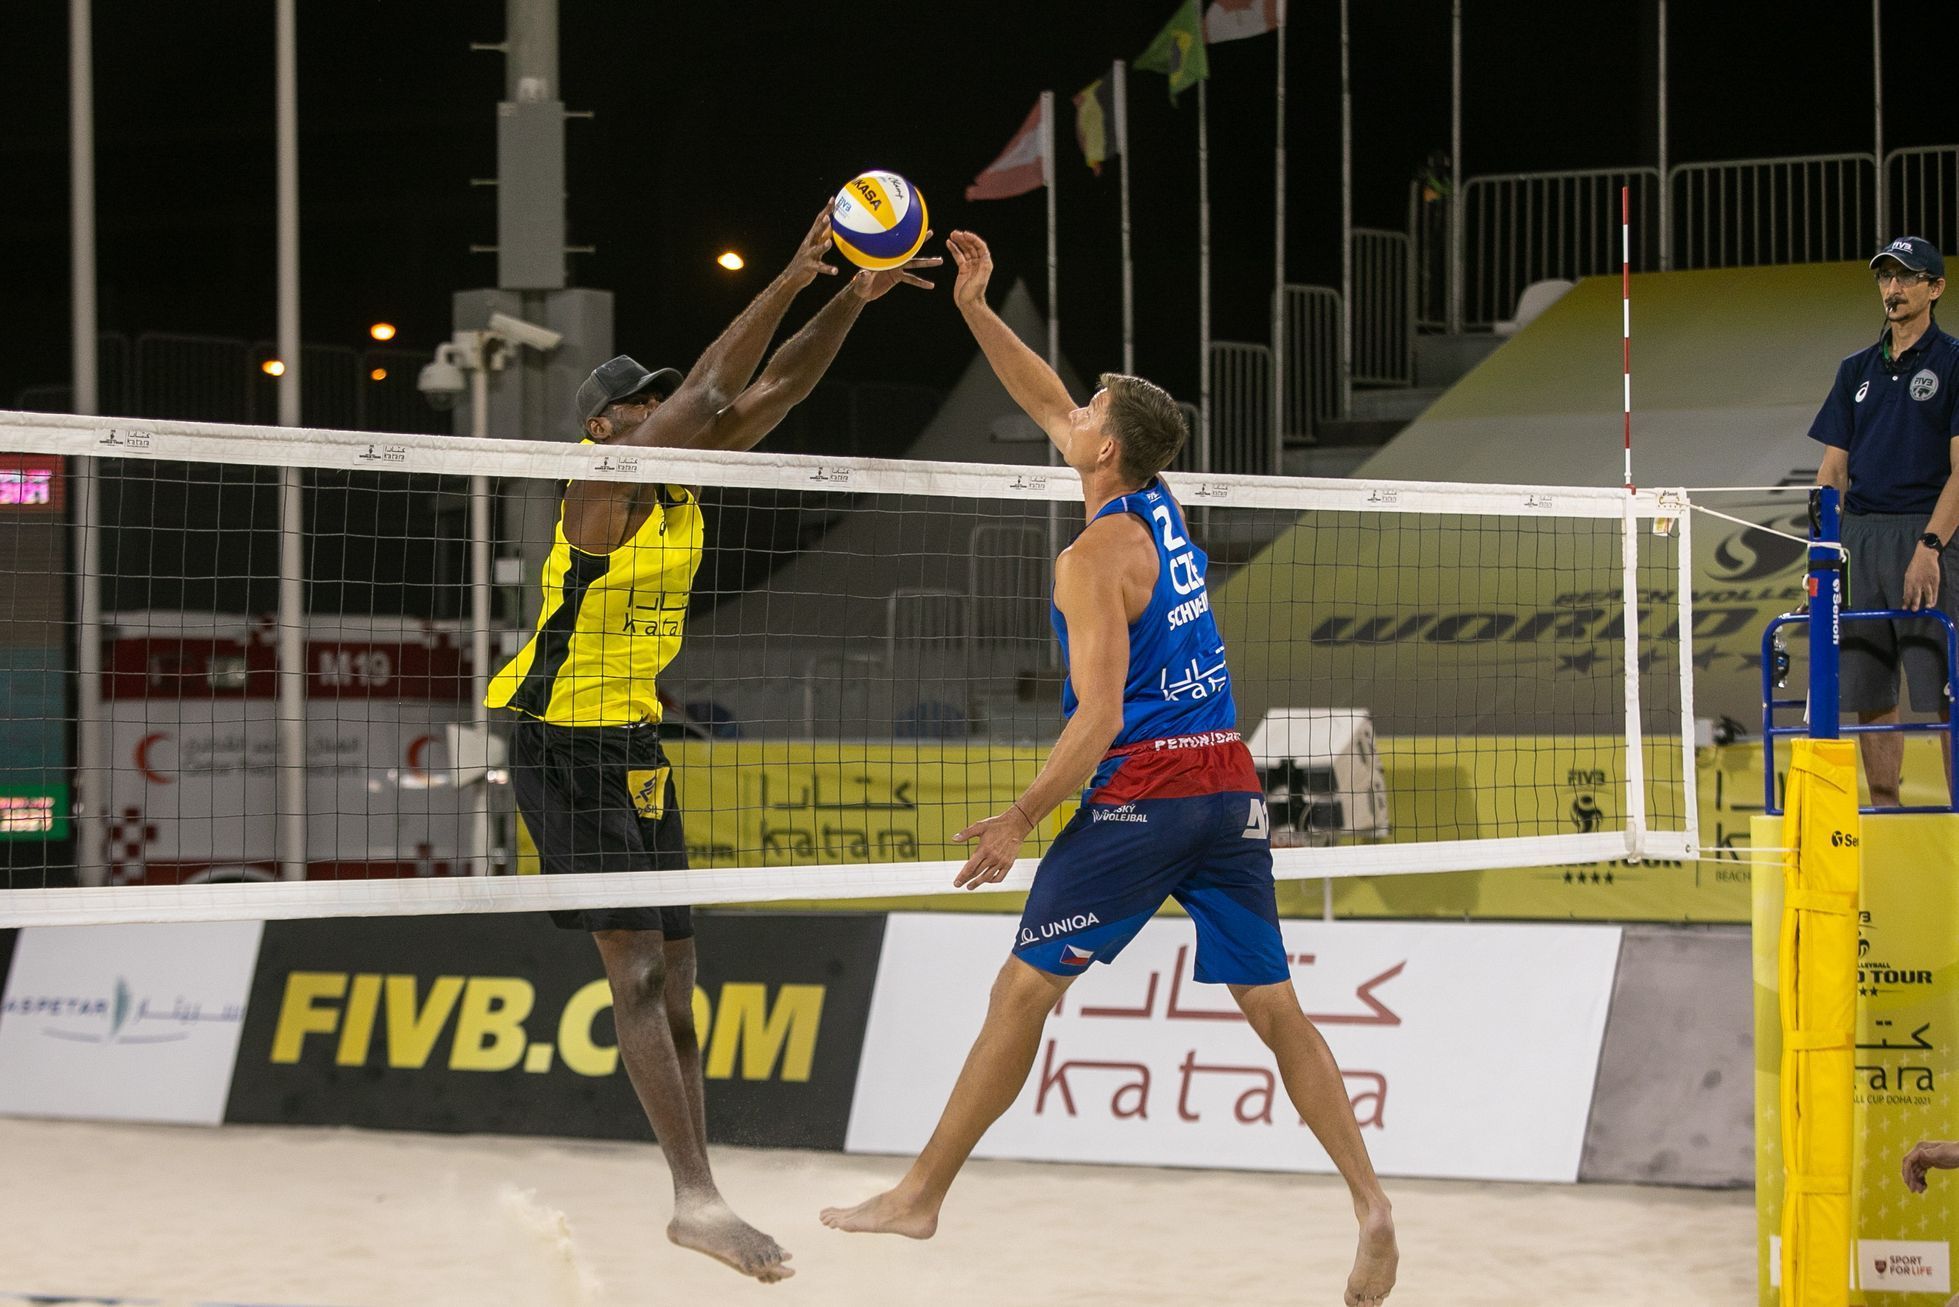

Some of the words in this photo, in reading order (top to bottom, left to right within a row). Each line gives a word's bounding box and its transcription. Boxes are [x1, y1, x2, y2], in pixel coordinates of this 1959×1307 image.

[1914, 376, 1934, 388] FIVB
[1152, 505, 1187, 552] 2
[1169, 551, 1205, 596] CZE
[622, 611, 688, 637] kata
[760, 818, 916, 858] katara
[1041, 912, 1100, 938] UNIQA
[1870, 970, 1933, 984] TOUR
[270, 971, 826, 1083] FIVB.CM
[1035, 1038, 1388, 1131] kataa
[1855, 1065, 1935, 1092] ara
[1889, 1266, 1911, 1276] FOR
[1912, 1267, 1932, 1276] LIFE
